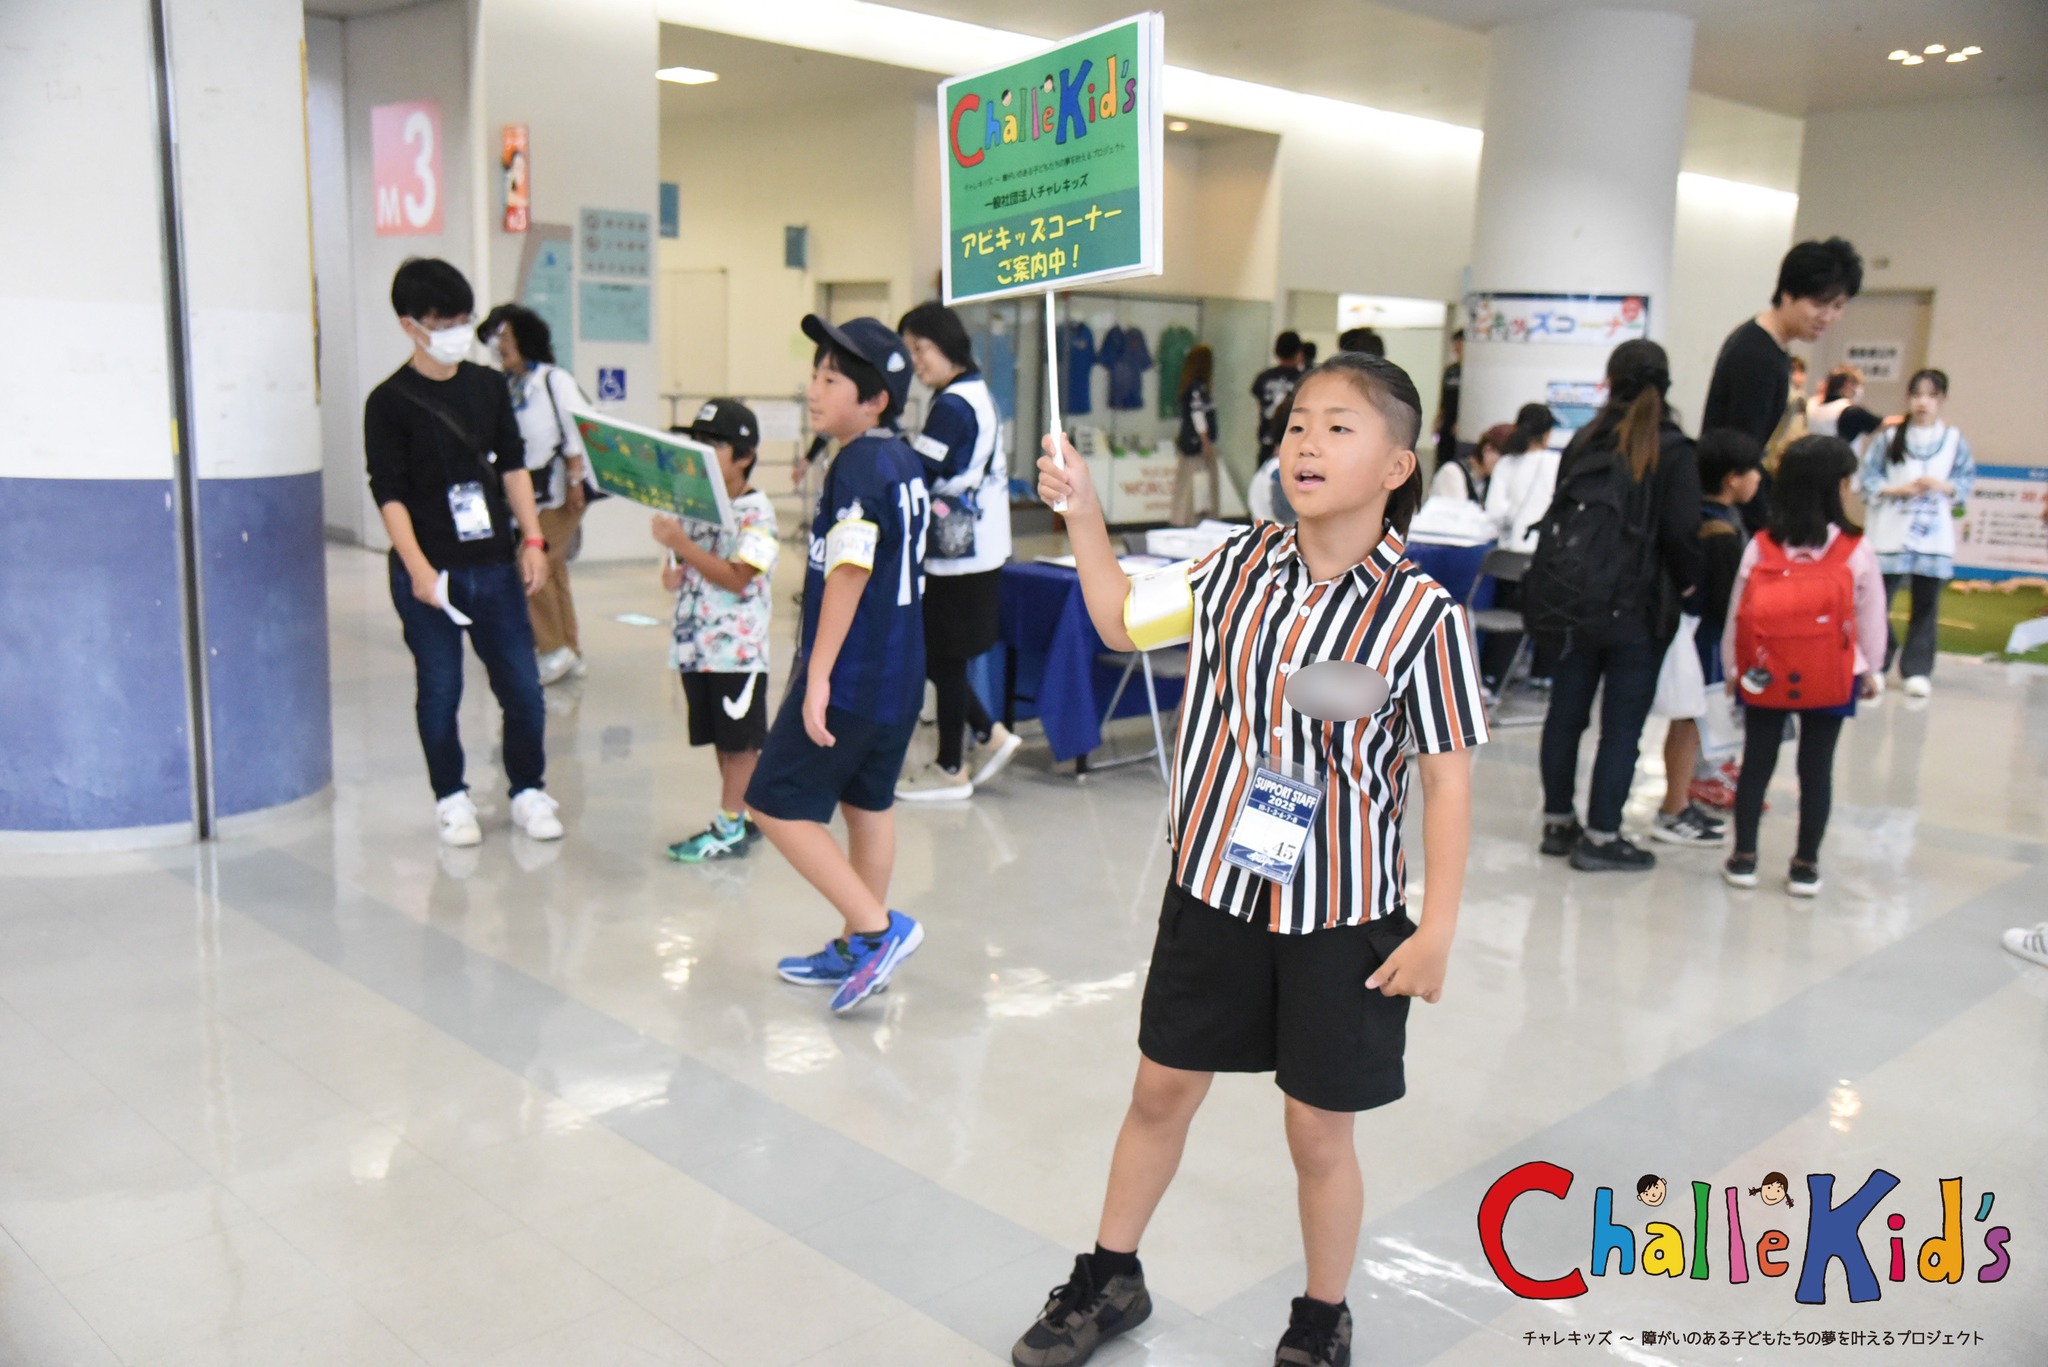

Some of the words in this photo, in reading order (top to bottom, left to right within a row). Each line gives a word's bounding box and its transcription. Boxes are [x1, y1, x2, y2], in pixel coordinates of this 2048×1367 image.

[950, 54, 1137, 168] ChalleKid's
[984, 173, 1089, 209] 一般社団法人チャレキッズ
[962, 205, 1122, 258] アビキッズコーナー
[1255, 777, 1293, 800] SUPPORT
[1291, 790, 1317, 809] STAFF
[1268, 795, 1296, 812] 2025
[1272, 842, 1296, 860] 45
